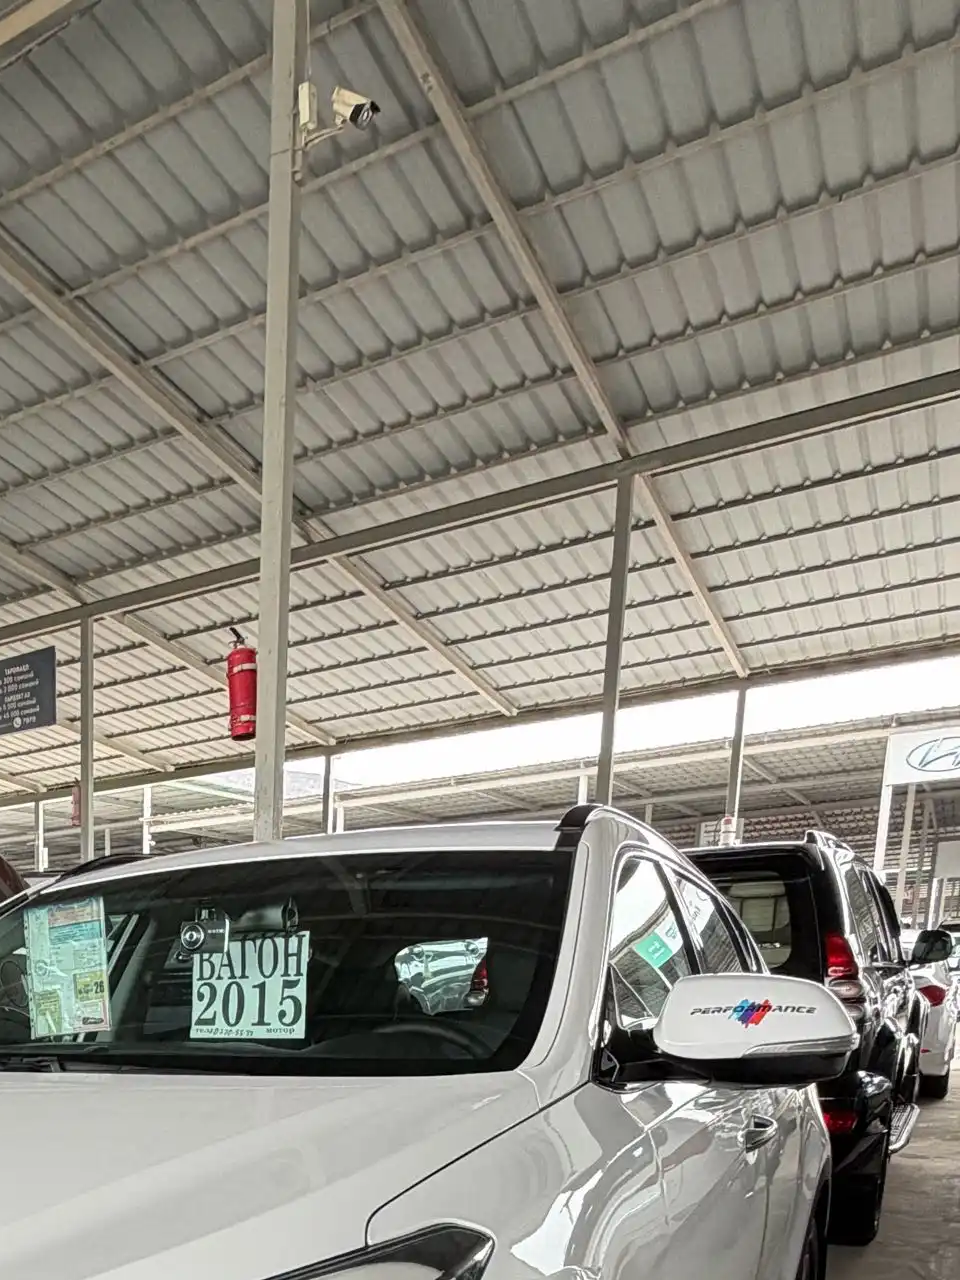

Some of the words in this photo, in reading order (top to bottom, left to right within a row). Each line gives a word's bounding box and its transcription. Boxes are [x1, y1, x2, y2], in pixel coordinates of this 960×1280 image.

[196, 934, 306, 981] ВАГОН
[194, 979, 303, 1027] 2015
[690, 1004, 818, 1016] PERFORMANCE
